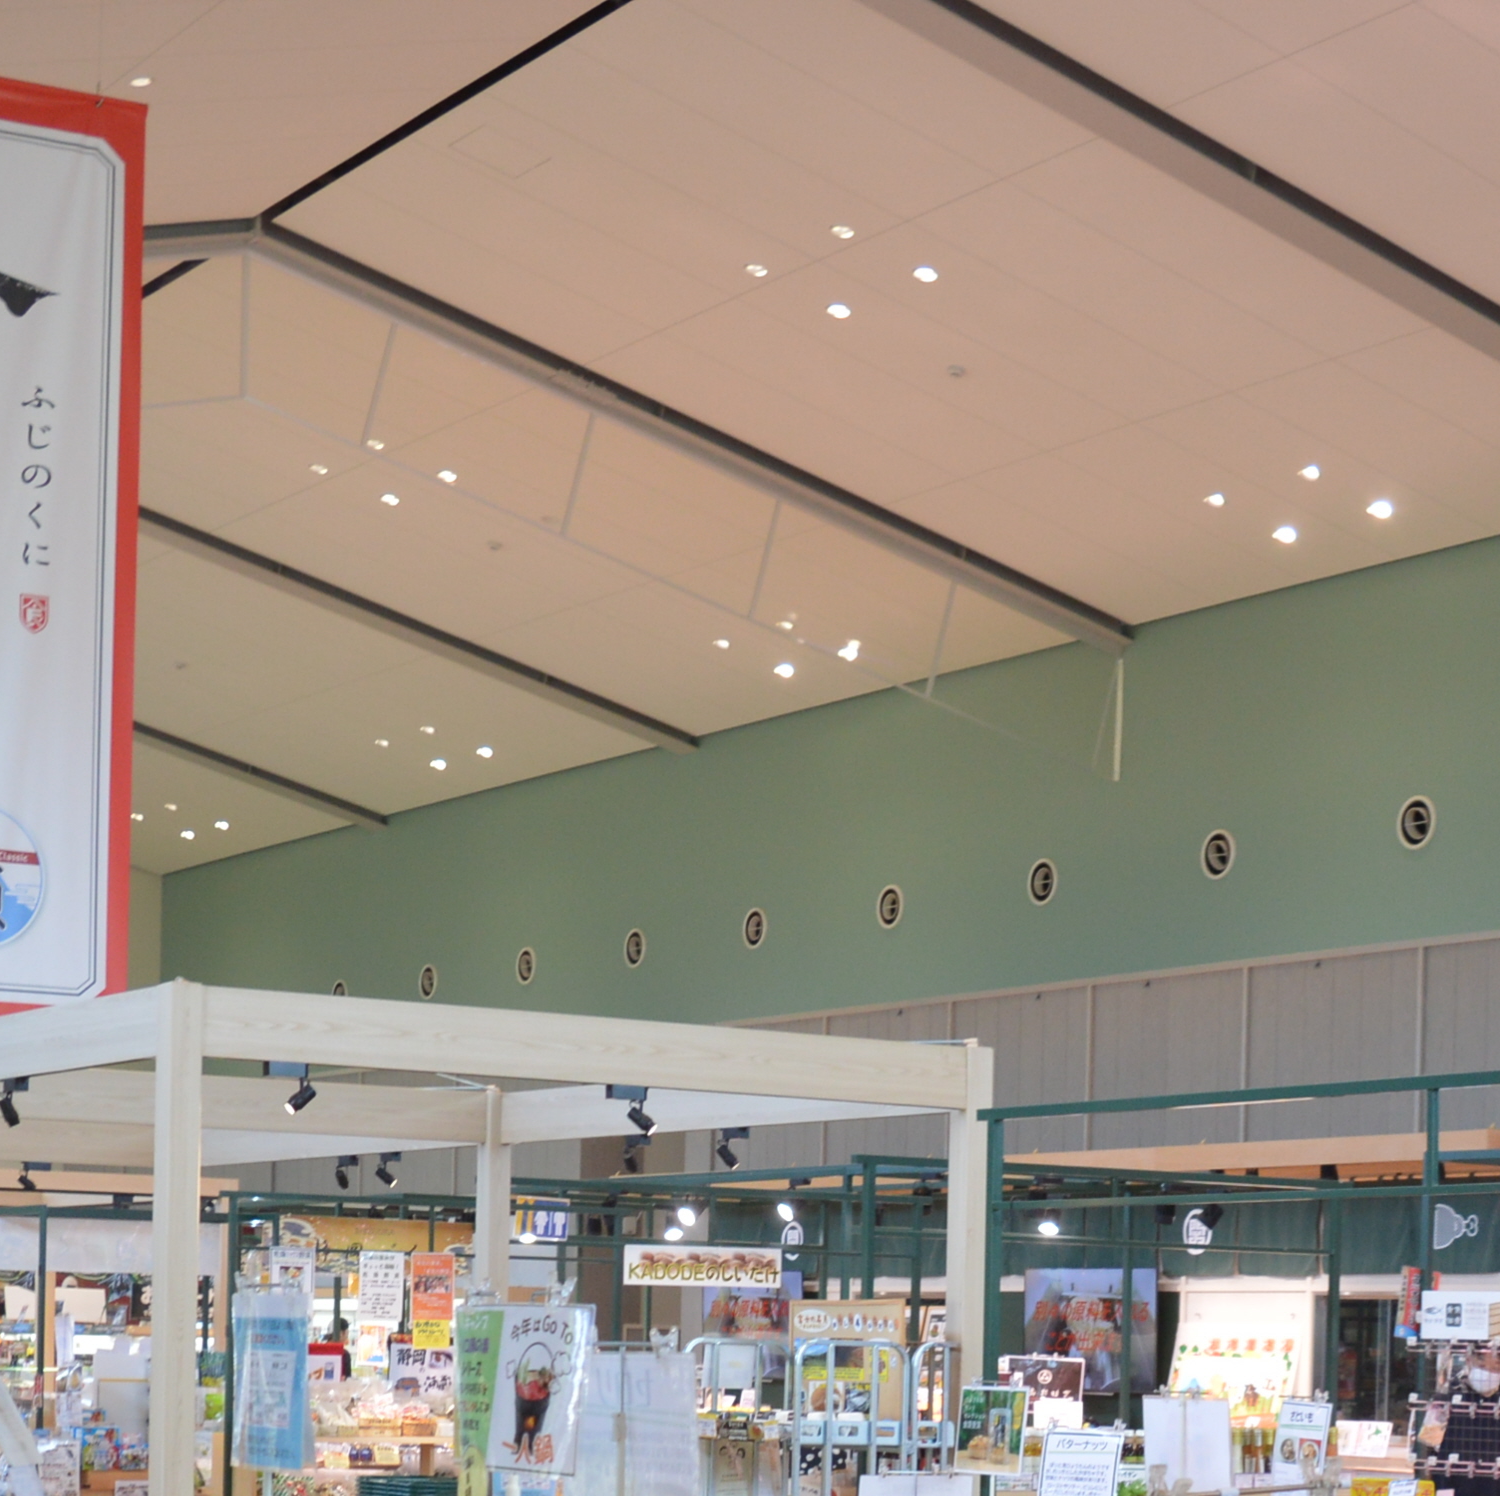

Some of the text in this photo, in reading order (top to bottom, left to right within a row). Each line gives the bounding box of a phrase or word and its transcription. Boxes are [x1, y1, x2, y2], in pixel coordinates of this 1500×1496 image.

[19, 384, 57, 571] ふじのくに
[627, 1262, 780, 1284] KADODEのしいたけ
[502, 1433, 554, 1465] 一人鍋
[1056, 1438, 1108, 1451] バターナッツ
